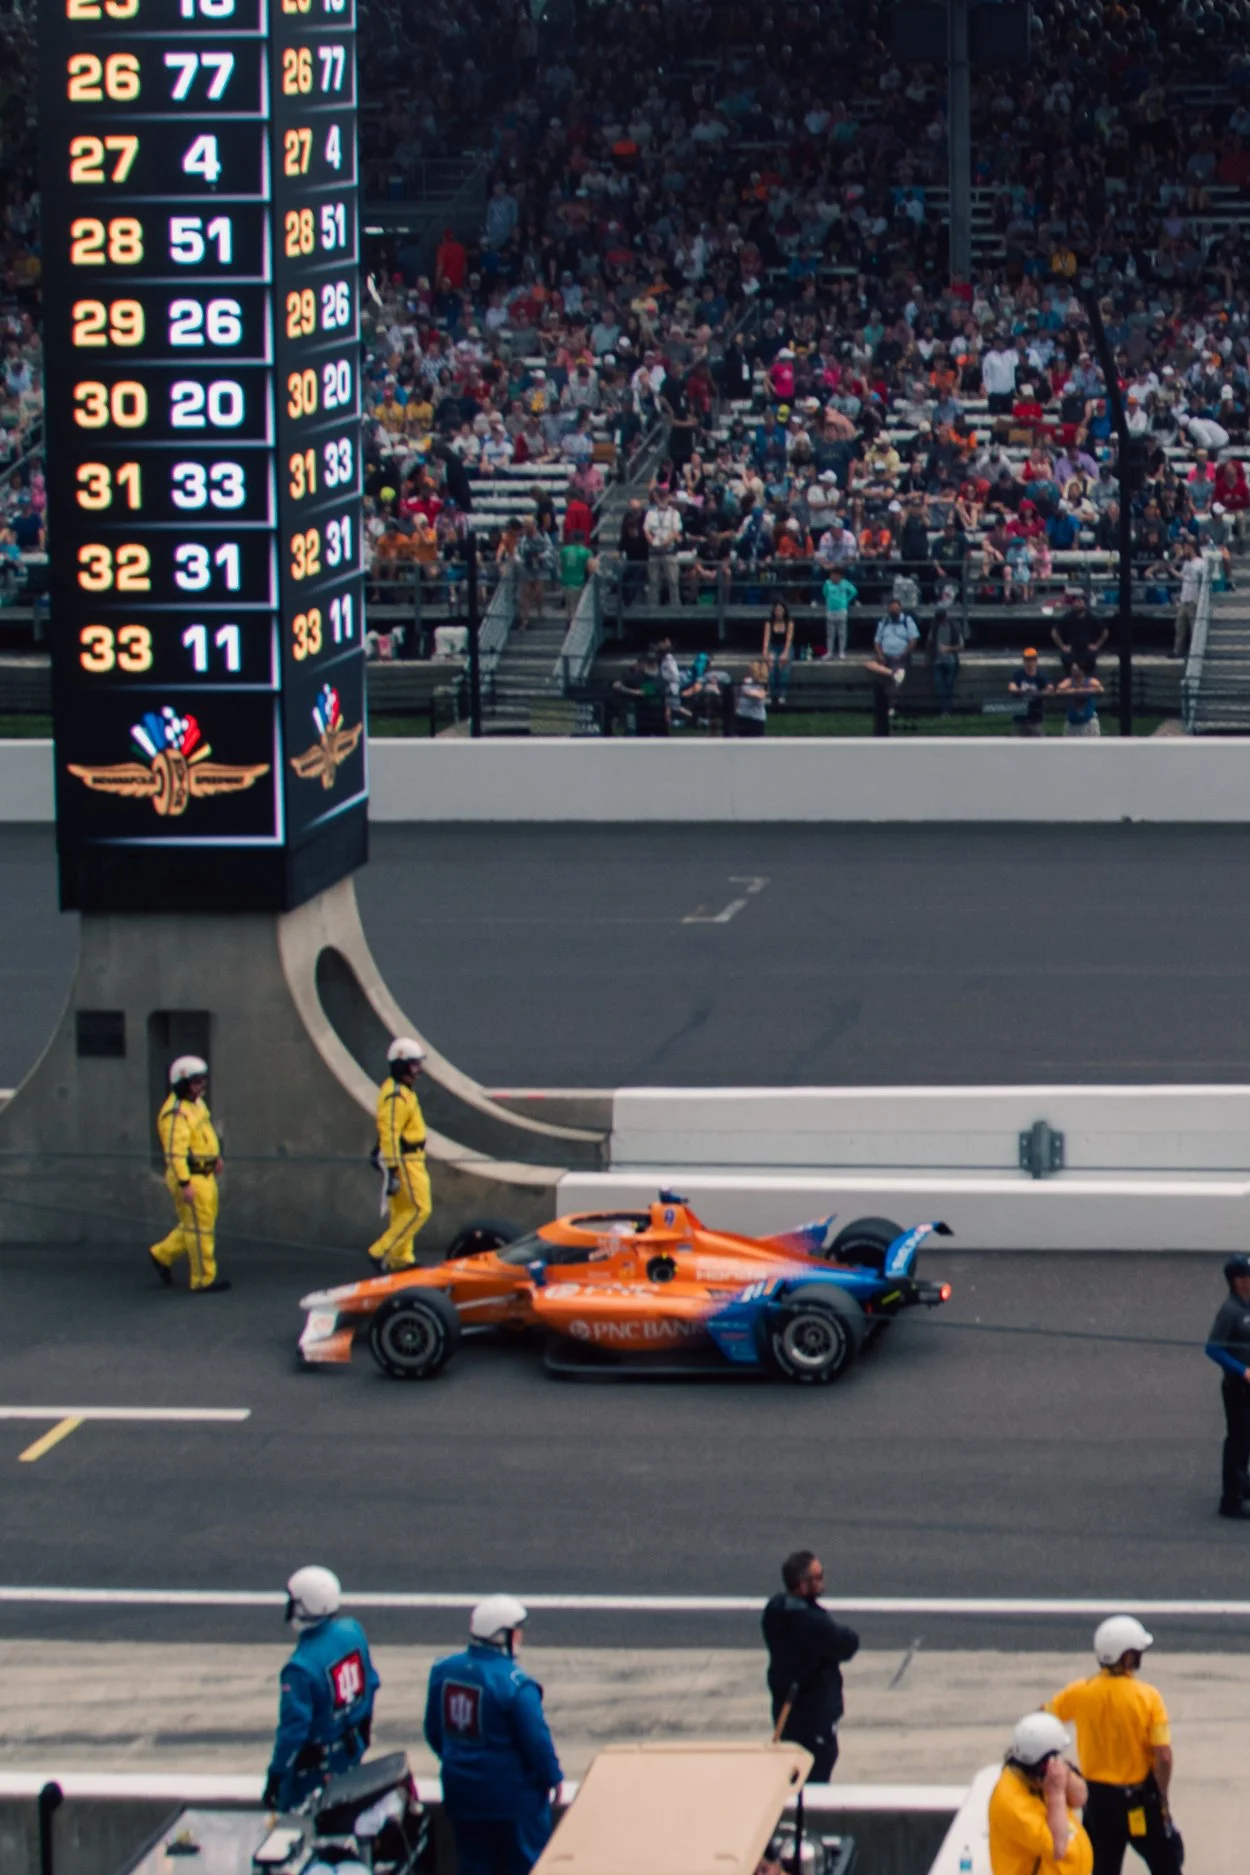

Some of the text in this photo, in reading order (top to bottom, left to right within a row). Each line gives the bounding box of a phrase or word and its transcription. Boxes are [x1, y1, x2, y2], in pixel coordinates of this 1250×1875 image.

[67, 51, 235, 101] 26 77
[282, 45, 346, 95] 26 77
[69, 134, 221, 183] 27 4
[284, 124, 342, 176] 27 4
[70, 216, 232, 264] 28 51
[285, 203, 346, 257] 28 51
[72, 298, 242, 346] 29 26
[286, 281, 349, 338] 29 26
[74, 380, 245, 428] 30 20
[288, 359, 351, 418] 30 20
[76, 462, 246, 510] 31 33
[289, 438, 353, 499] 31 33
[78, 543, 240, 591] 32 31
[291, 515, 352, 580] 32 31
[80, 624, 240, 672] 33 11
[292, 594, 353, 660] 33 11
[593, 1321, 641, 1340] PNC
